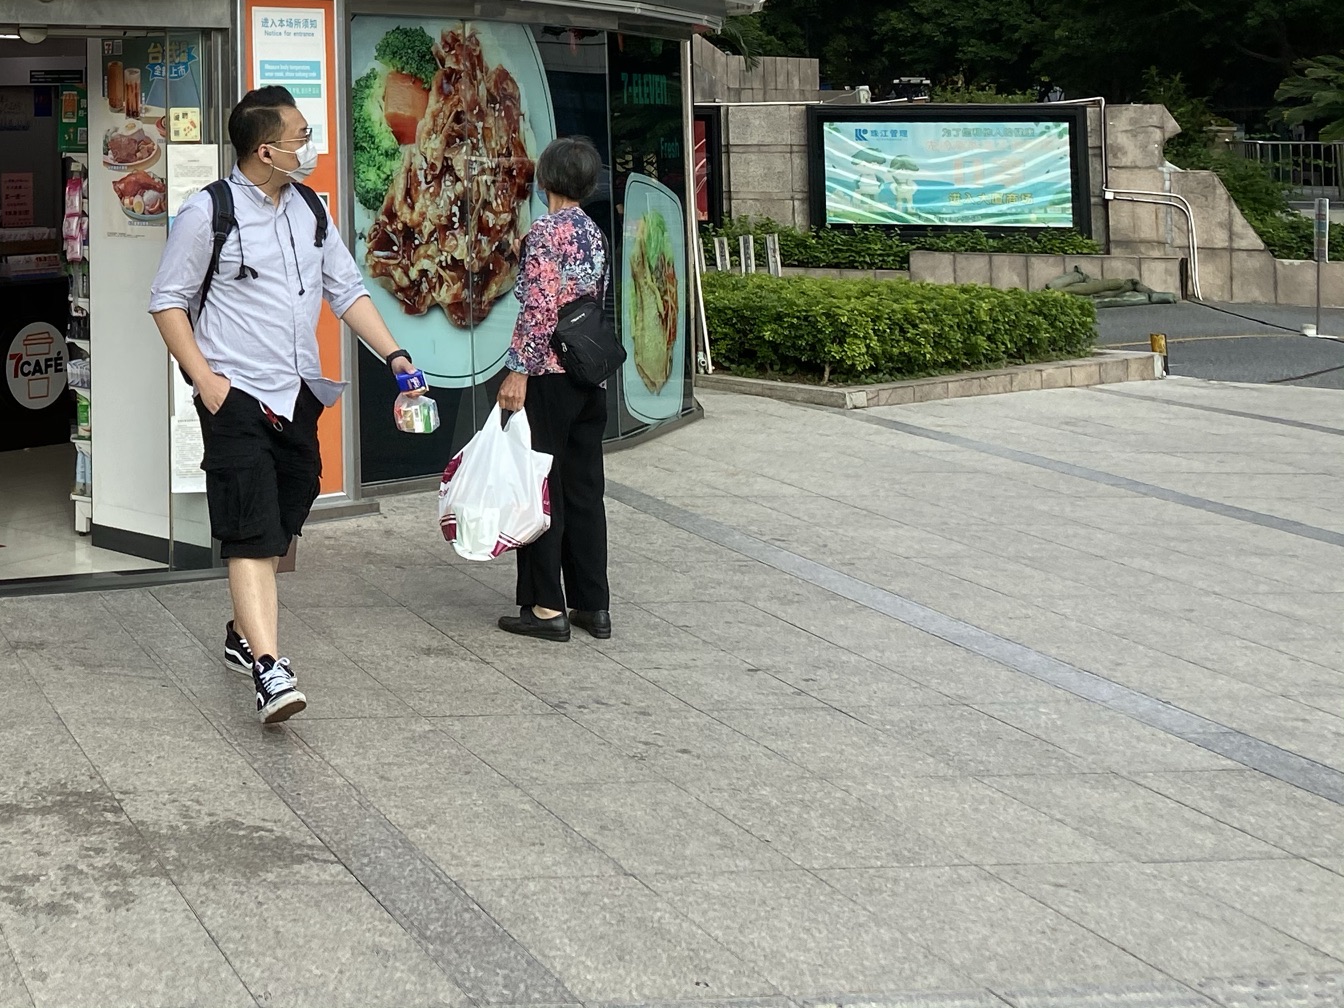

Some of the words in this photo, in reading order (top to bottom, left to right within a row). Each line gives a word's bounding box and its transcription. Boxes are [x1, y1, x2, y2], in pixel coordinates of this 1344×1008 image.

[261, 17, 317, 29] 进入本场所须知
